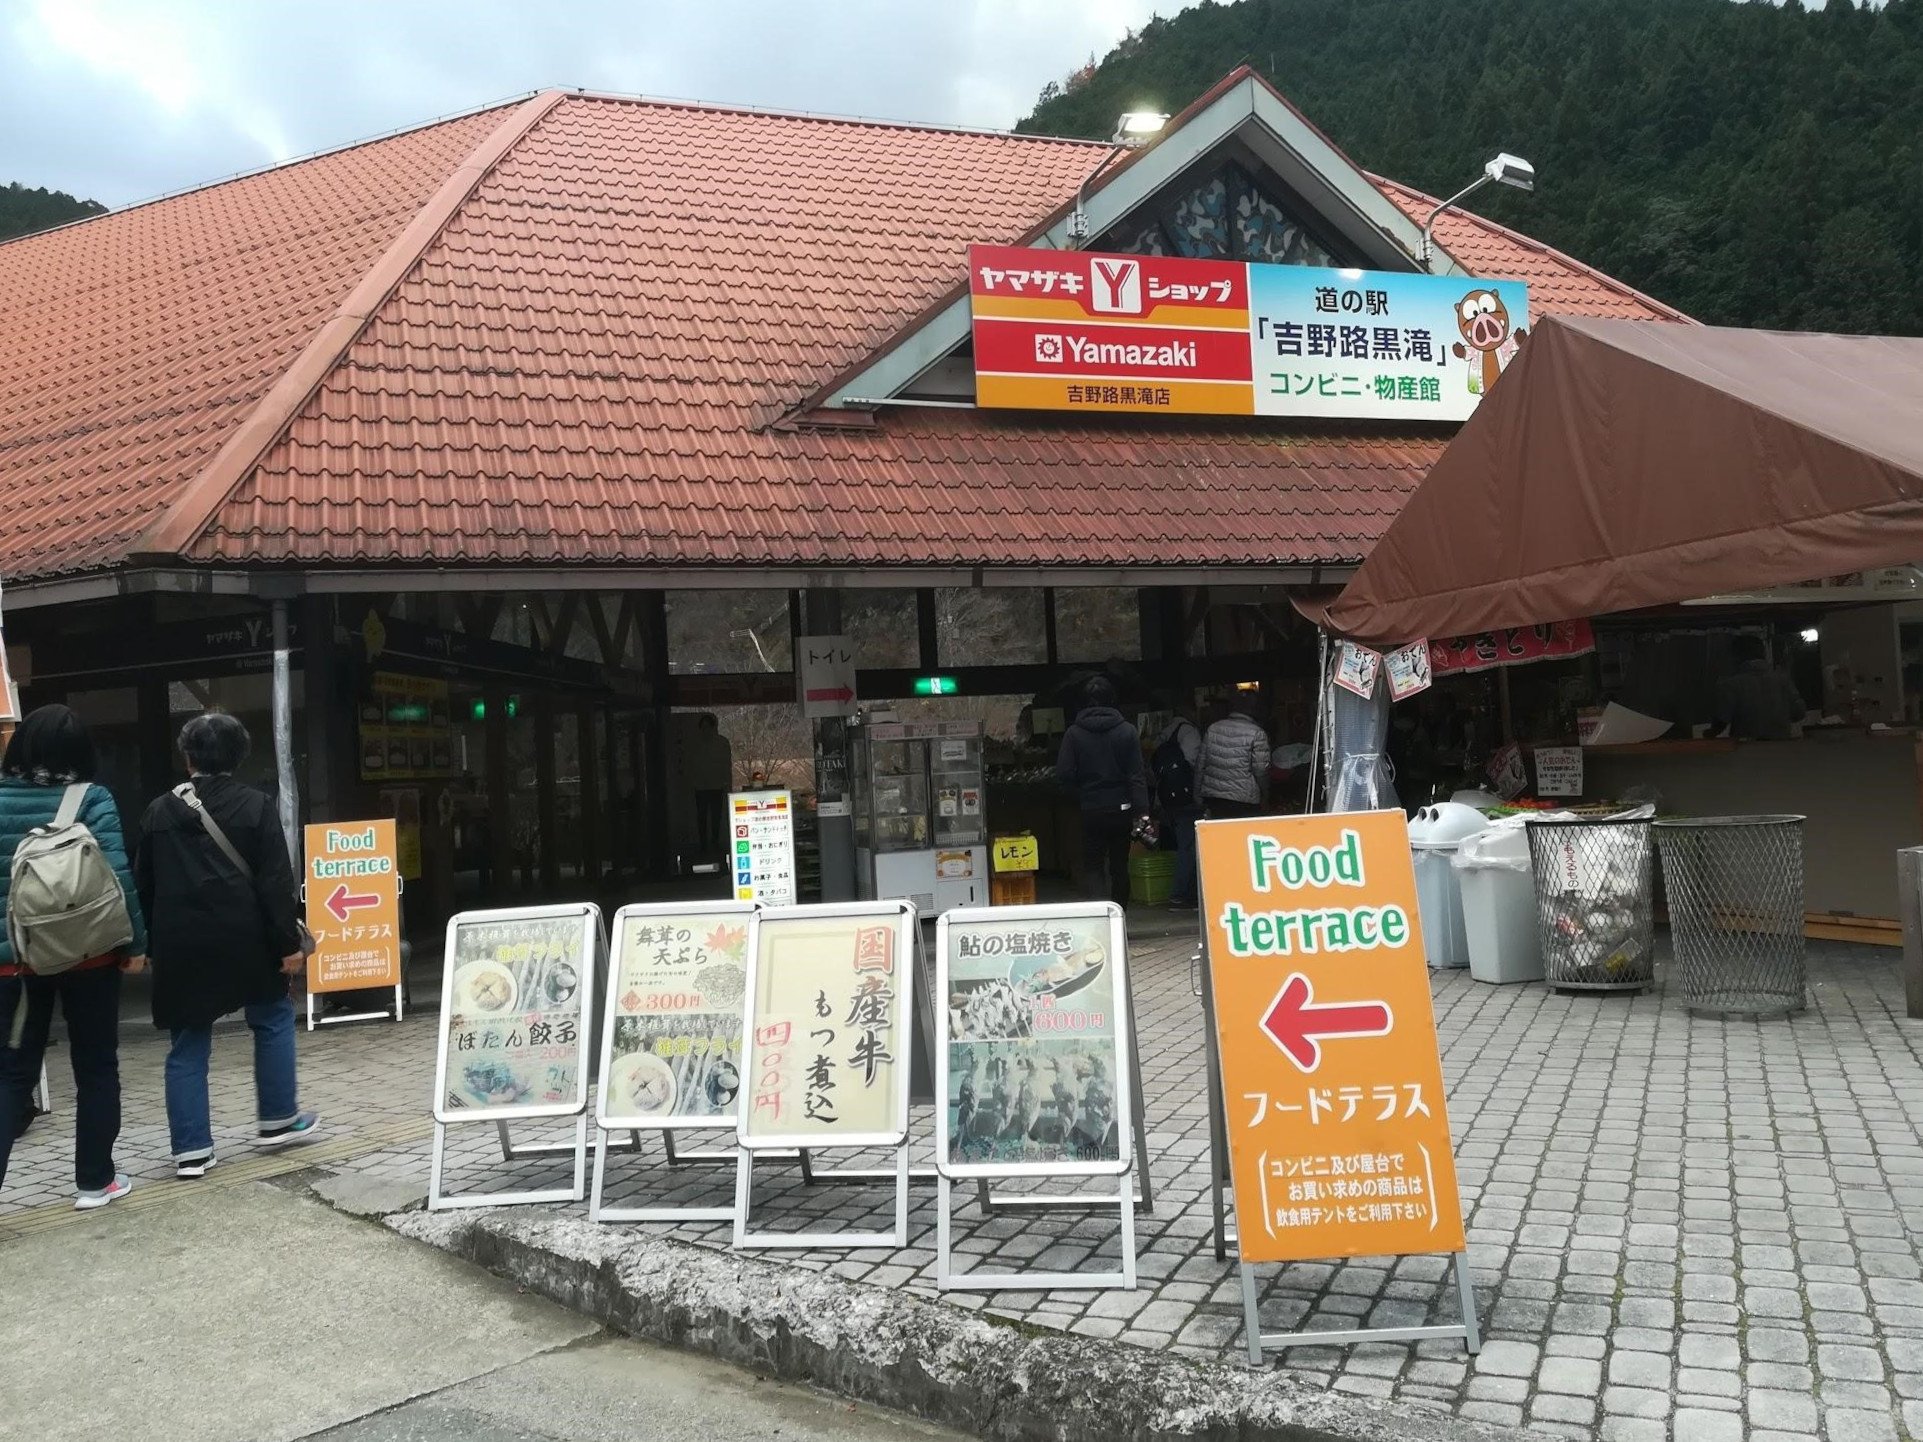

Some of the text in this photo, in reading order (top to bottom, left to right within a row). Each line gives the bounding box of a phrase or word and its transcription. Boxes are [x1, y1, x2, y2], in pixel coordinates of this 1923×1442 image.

[979, 260, 1233, 310] ヤマザキ Y ショップ
[1315, 286, 1390, 317] 道の駅
[1065, 334, 1197, 369] Yamazaki
[1258, 316, 1448, 368] 「吉野路黒滝」
[1067, 383, 1171, 407] 吉野路黒滝店
[1270, 372, 1442, 403] コンビニ・物産館
[809, 649, 852, 665] トイレ
[1354, 647, 1378, 667] おでん
[1400, 642, 1428, 663] おでん
[328, 828, 375, 852] Food
[1001, 846, 1034, 859] レモン
[314, 857, 391, 878] terrace
[1250, 831, 1363, 890] Food
[316, 924, 392, 945] フードテラス
[635, 924, 692, 947] 舞茸の
[1222, 904, 1407, 954] terrace
[652, 947, 708, 966] 天ぷら
[958, 930, 1074, 958] 鮎の塩焼き
[646, 993, 701, 1010] 300円
[845, 926, 895, 1088] 国産牛
[456, 1020, 577, 1051] ぼたん餃子
[804, 990, 839, 1123] もつ煮込
[1243, 1083, 1430, 1128] フードテラス
[1271, 1153, 1405, 1178] コンビニ及び屋台で
[1288, 1176, 1424, 1202] お買い求めの商品は
[1276, 1202, 1428, 1227] 飲食用テントをご利用下さい
